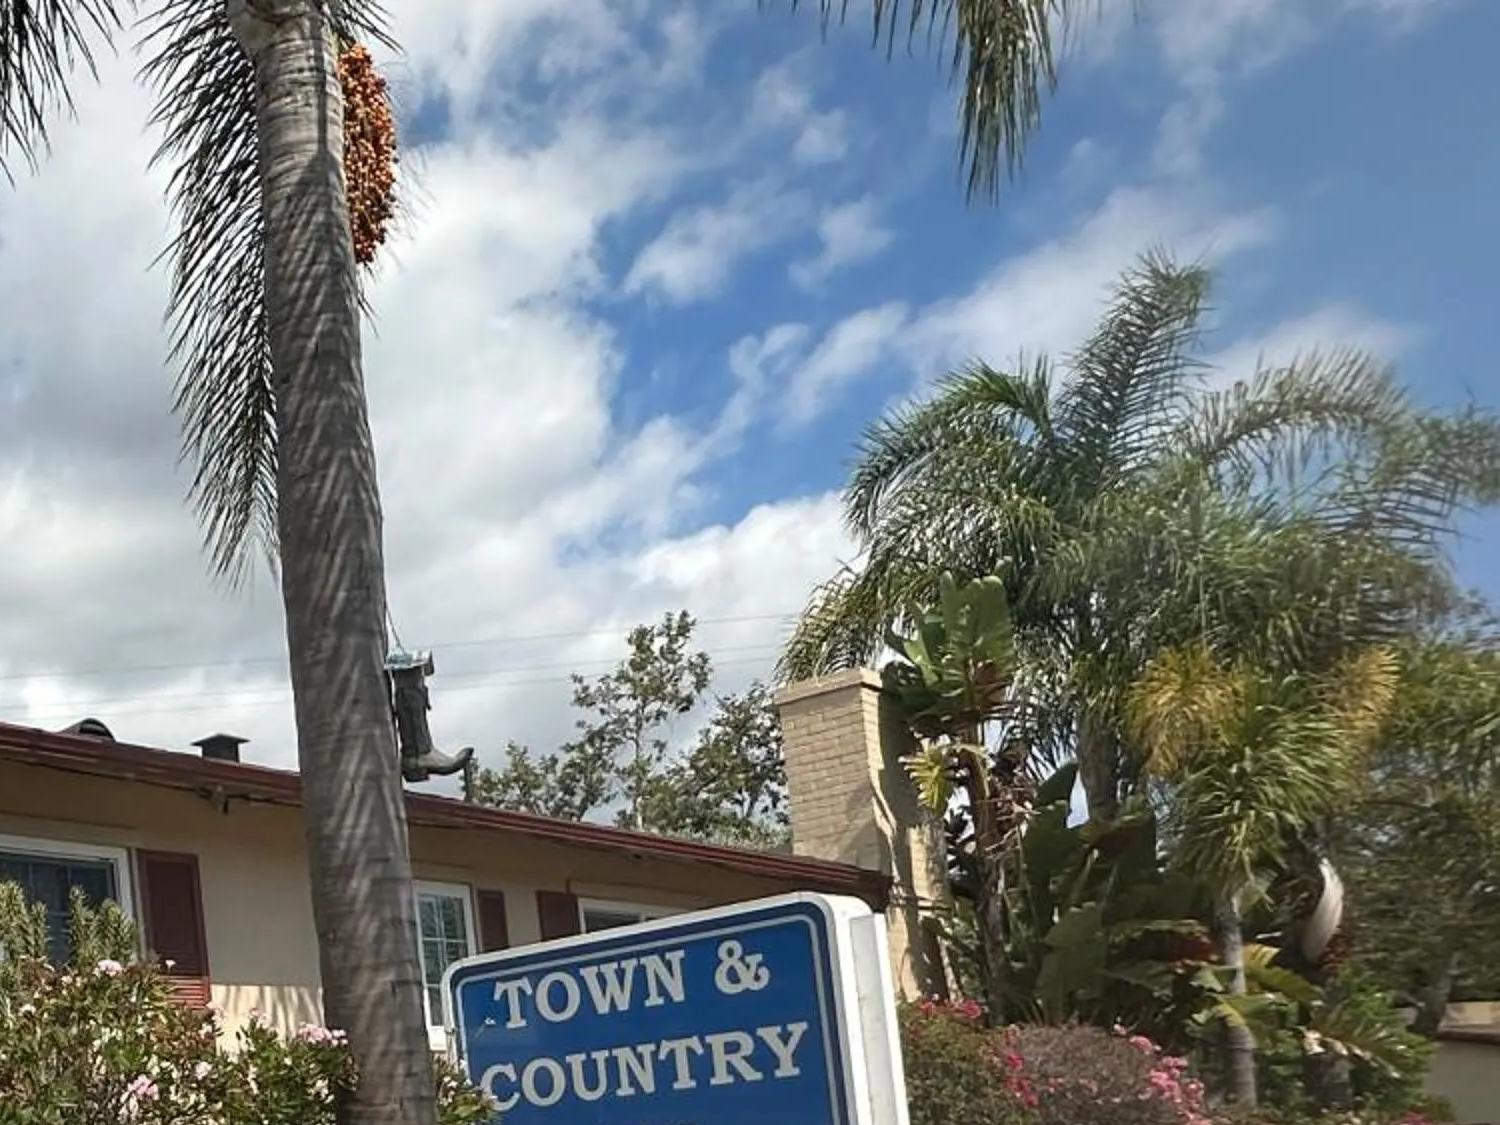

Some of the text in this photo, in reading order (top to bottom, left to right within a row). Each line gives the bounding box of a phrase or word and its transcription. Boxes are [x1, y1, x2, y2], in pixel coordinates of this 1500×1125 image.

[493, 939, 771, 1030] TOWN &
[480, 1021, 808, 1112] COUNTRY
